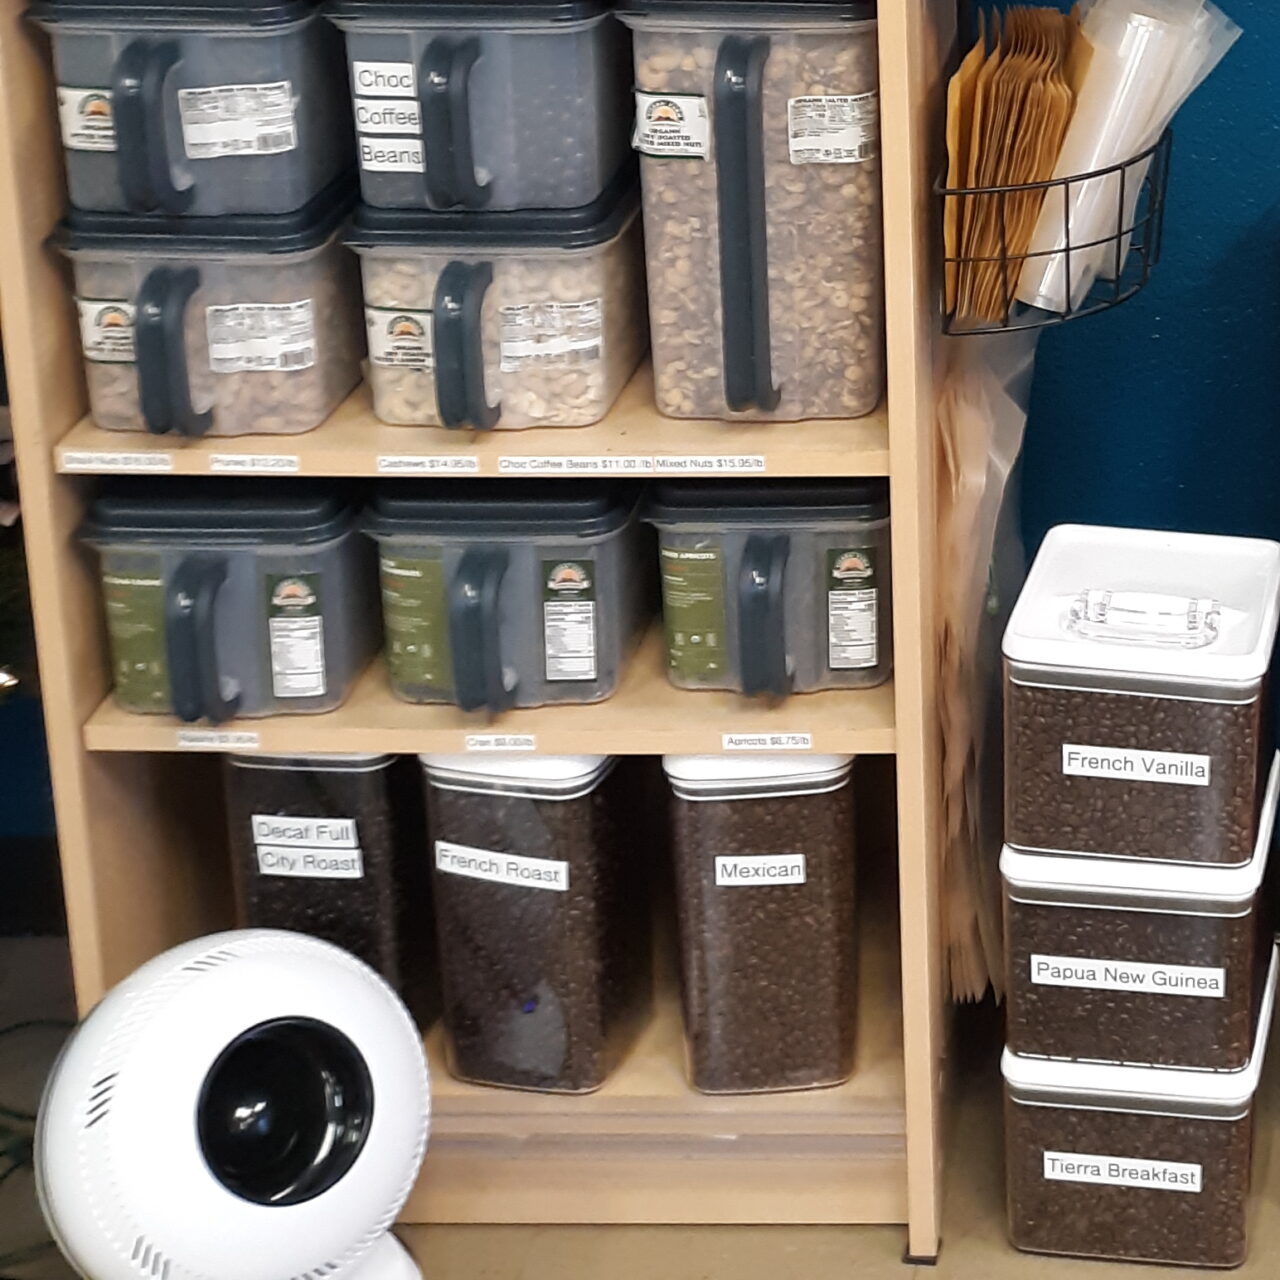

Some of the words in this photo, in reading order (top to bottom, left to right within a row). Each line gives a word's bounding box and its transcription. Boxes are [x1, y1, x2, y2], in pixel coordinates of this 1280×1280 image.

[358, 70, 413, 88] Choc
[356, 106, 420, 126] Coffee
[361, 145, 424, 164] Beans
[500, 459, 526, 469] Choc
[528, 459, 563, 469] Coffee
[566, 459, 599, 469] Beans
[656, 459, 688, 468] Mixed
[690, 459, 713, 468] Nuts
[727, 736, 767, 746] Apricots
[1066, 751, 1136, 773] French
[1141, 756, 1207, 779] Vanilla
[259, 821, 312, 841] Decaf
[317, 823, 351, 842] Full
[260, 850, 301, 874] City
[304, 853, 358, 871] Roast
[438, 848, 500, 875] French
[505, 862, 562, 884] Roast
[720, 861, 802, 880] Mexican
[1035, 960, 1098, 983] Papua
[1102, 965, 1144, 985] New
[1149, 970, 1220, 991] Guinea
[1047, 1158, 1102, 1177] Tierra
[1107, 1162, 1197, 1186] Breakfast
